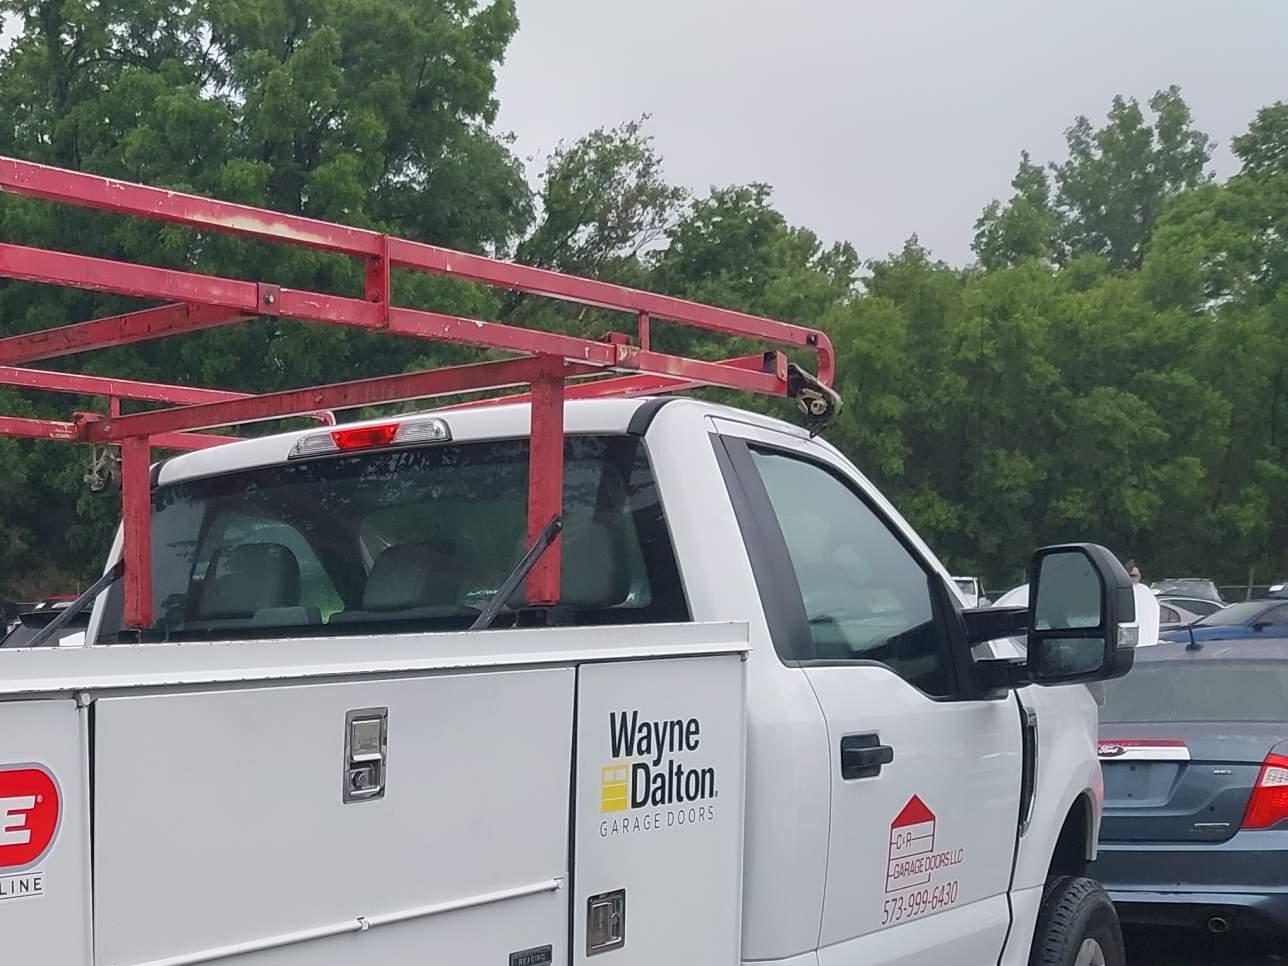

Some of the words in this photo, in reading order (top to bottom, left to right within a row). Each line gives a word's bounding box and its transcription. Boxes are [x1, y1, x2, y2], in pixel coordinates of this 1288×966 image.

[610, 710, 700, 767] Wayne
[600, 813, 662, 838] GARAGE
[667, 806, 714, 827] DOORS
[893, 858, 924, 879] GARAGE
[924, 851, 951, 872] DOORS
[950, 848, 964, 866] LLC
[881, 880, 959, 925] 573-999-6430
